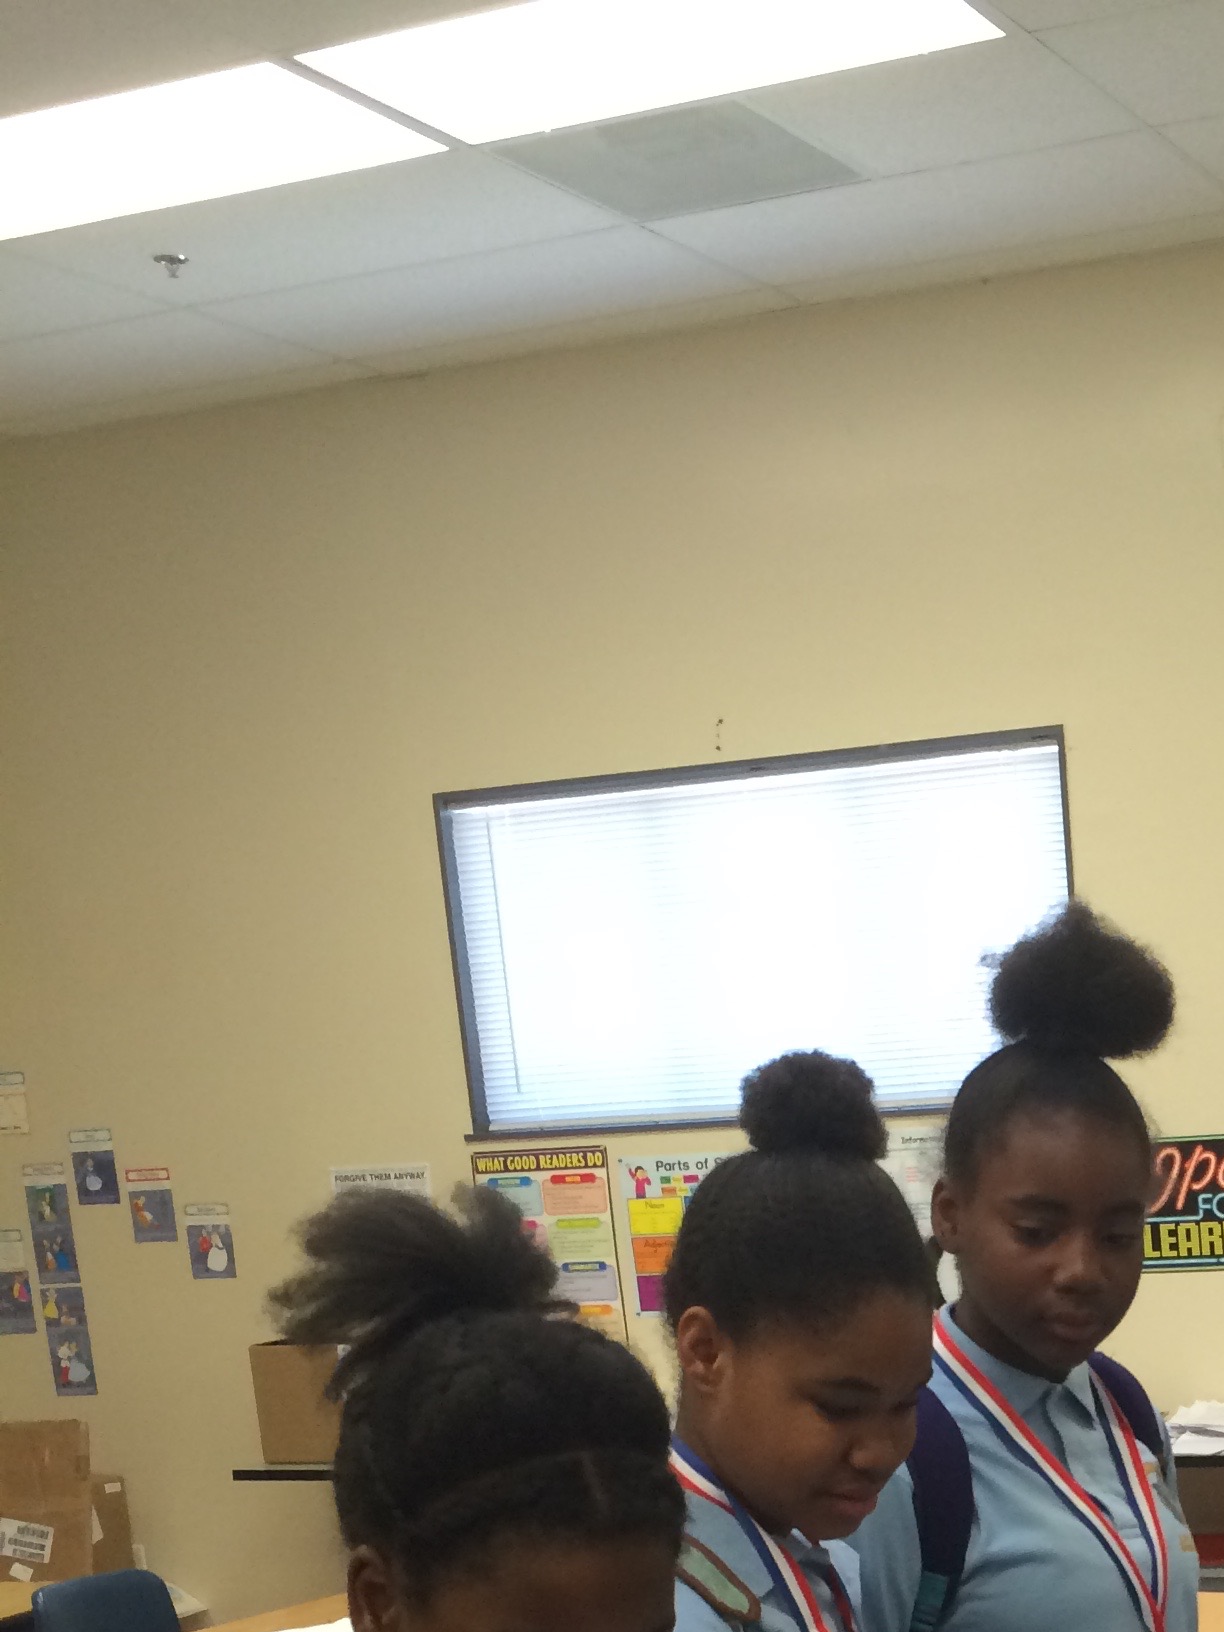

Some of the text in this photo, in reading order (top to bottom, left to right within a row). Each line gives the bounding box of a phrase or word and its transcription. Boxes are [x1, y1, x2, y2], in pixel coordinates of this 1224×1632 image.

[476, 1151, 603, 1173] WHAT GOOD READERS DO
[655, 1160, 690, 1172] Parts
[695, 1158, 709, 1170] of
[335, 1173, 367, 1184] FORGIVE
[369, 1172, 392, 1183] THEM
